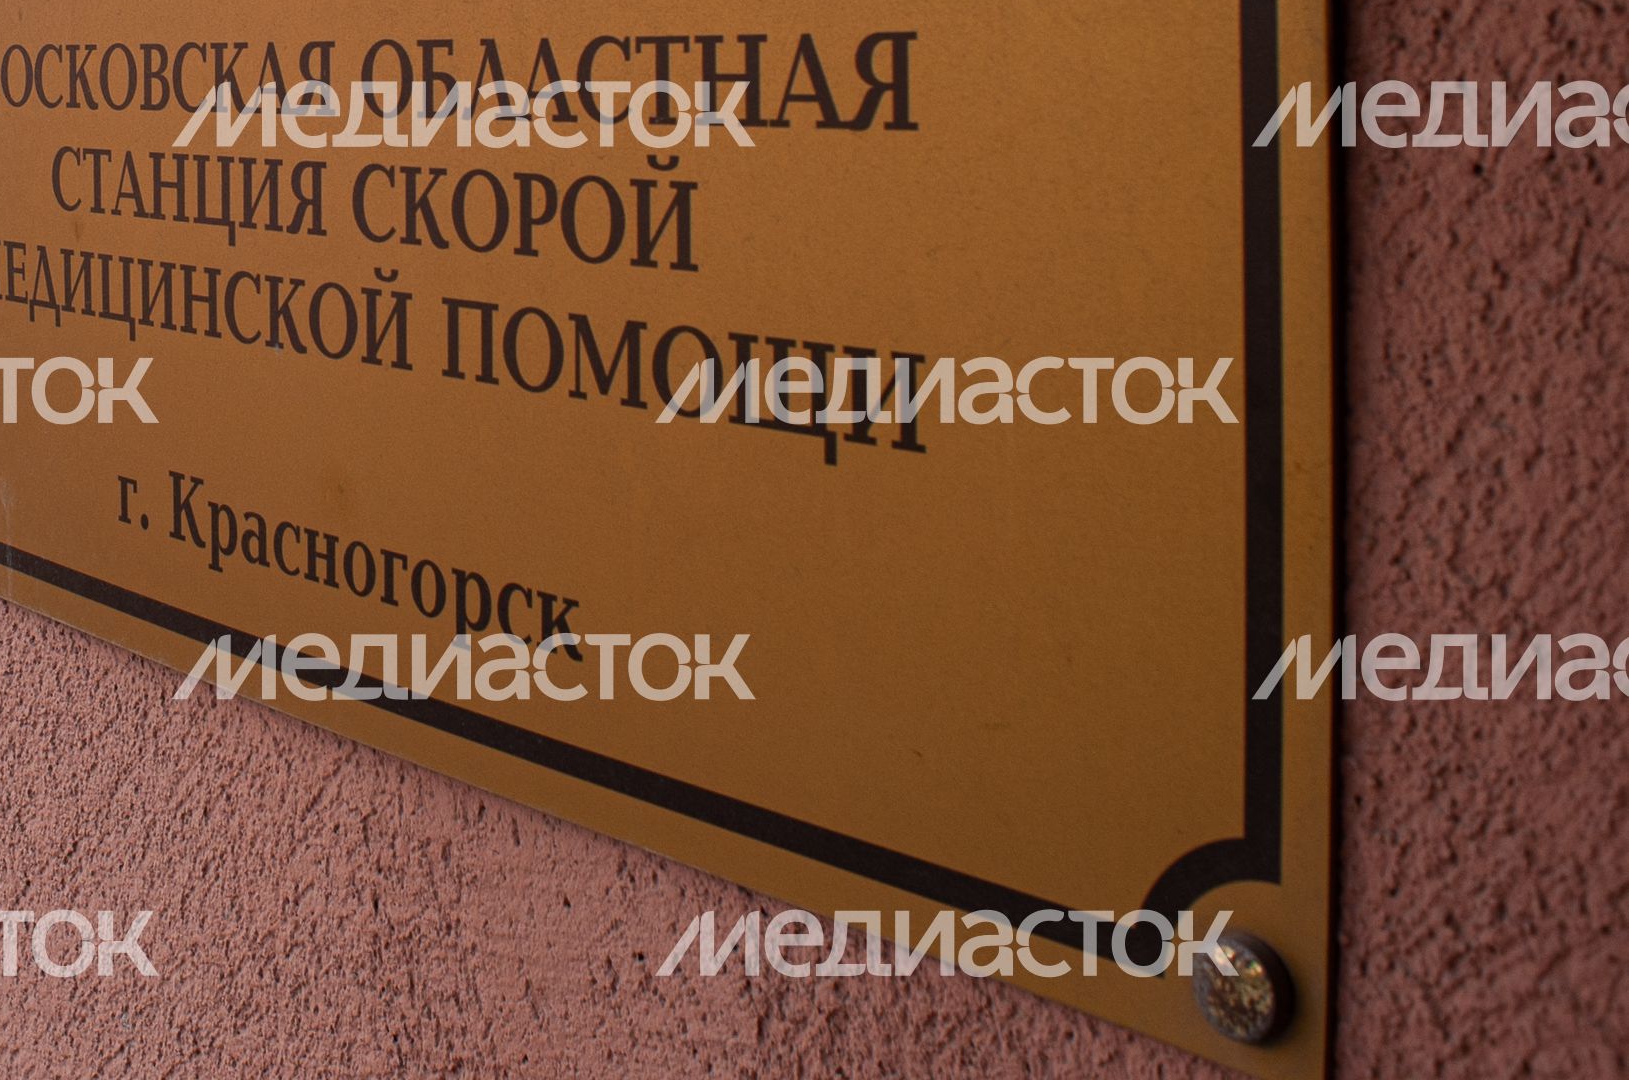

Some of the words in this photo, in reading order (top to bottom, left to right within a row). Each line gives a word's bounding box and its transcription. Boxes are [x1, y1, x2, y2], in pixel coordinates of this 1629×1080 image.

[361, 31, 920, 132] ОБЛАСТНАЯ
[51, 146, 328, 247] СТАНЦИЯ
[352, 154, 700, 273] СКОРОЙ
[441, 296, 927, 467] ПОМОЩИ
[118, 474, 150, 531] г.
[168, 470, 584, 663] Красногорск
